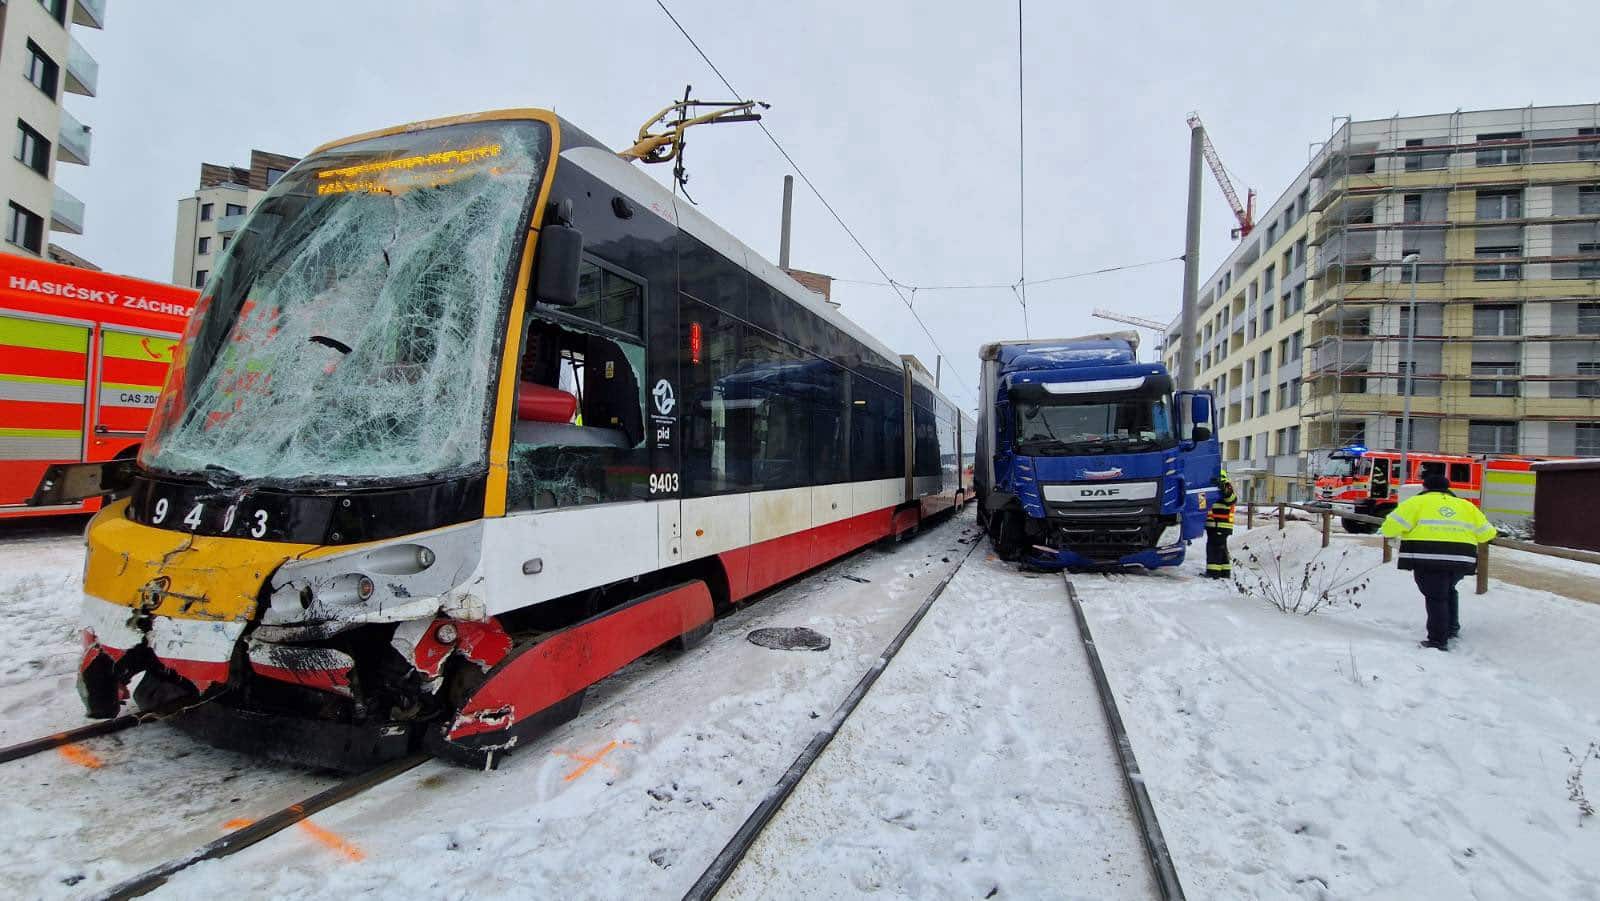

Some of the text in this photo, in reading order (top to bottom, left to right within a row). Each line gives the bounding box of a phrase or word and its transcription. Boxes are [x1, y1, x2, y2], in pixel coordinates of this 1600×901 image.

[9, 276, 119, 305] HASIČSKÝ
[120, 393, 141, 403] CAS
[657, 426, 670, 442] pid
[650, 473, 679, 494] 9403
[1080, 488, 1120, 497] DAF
